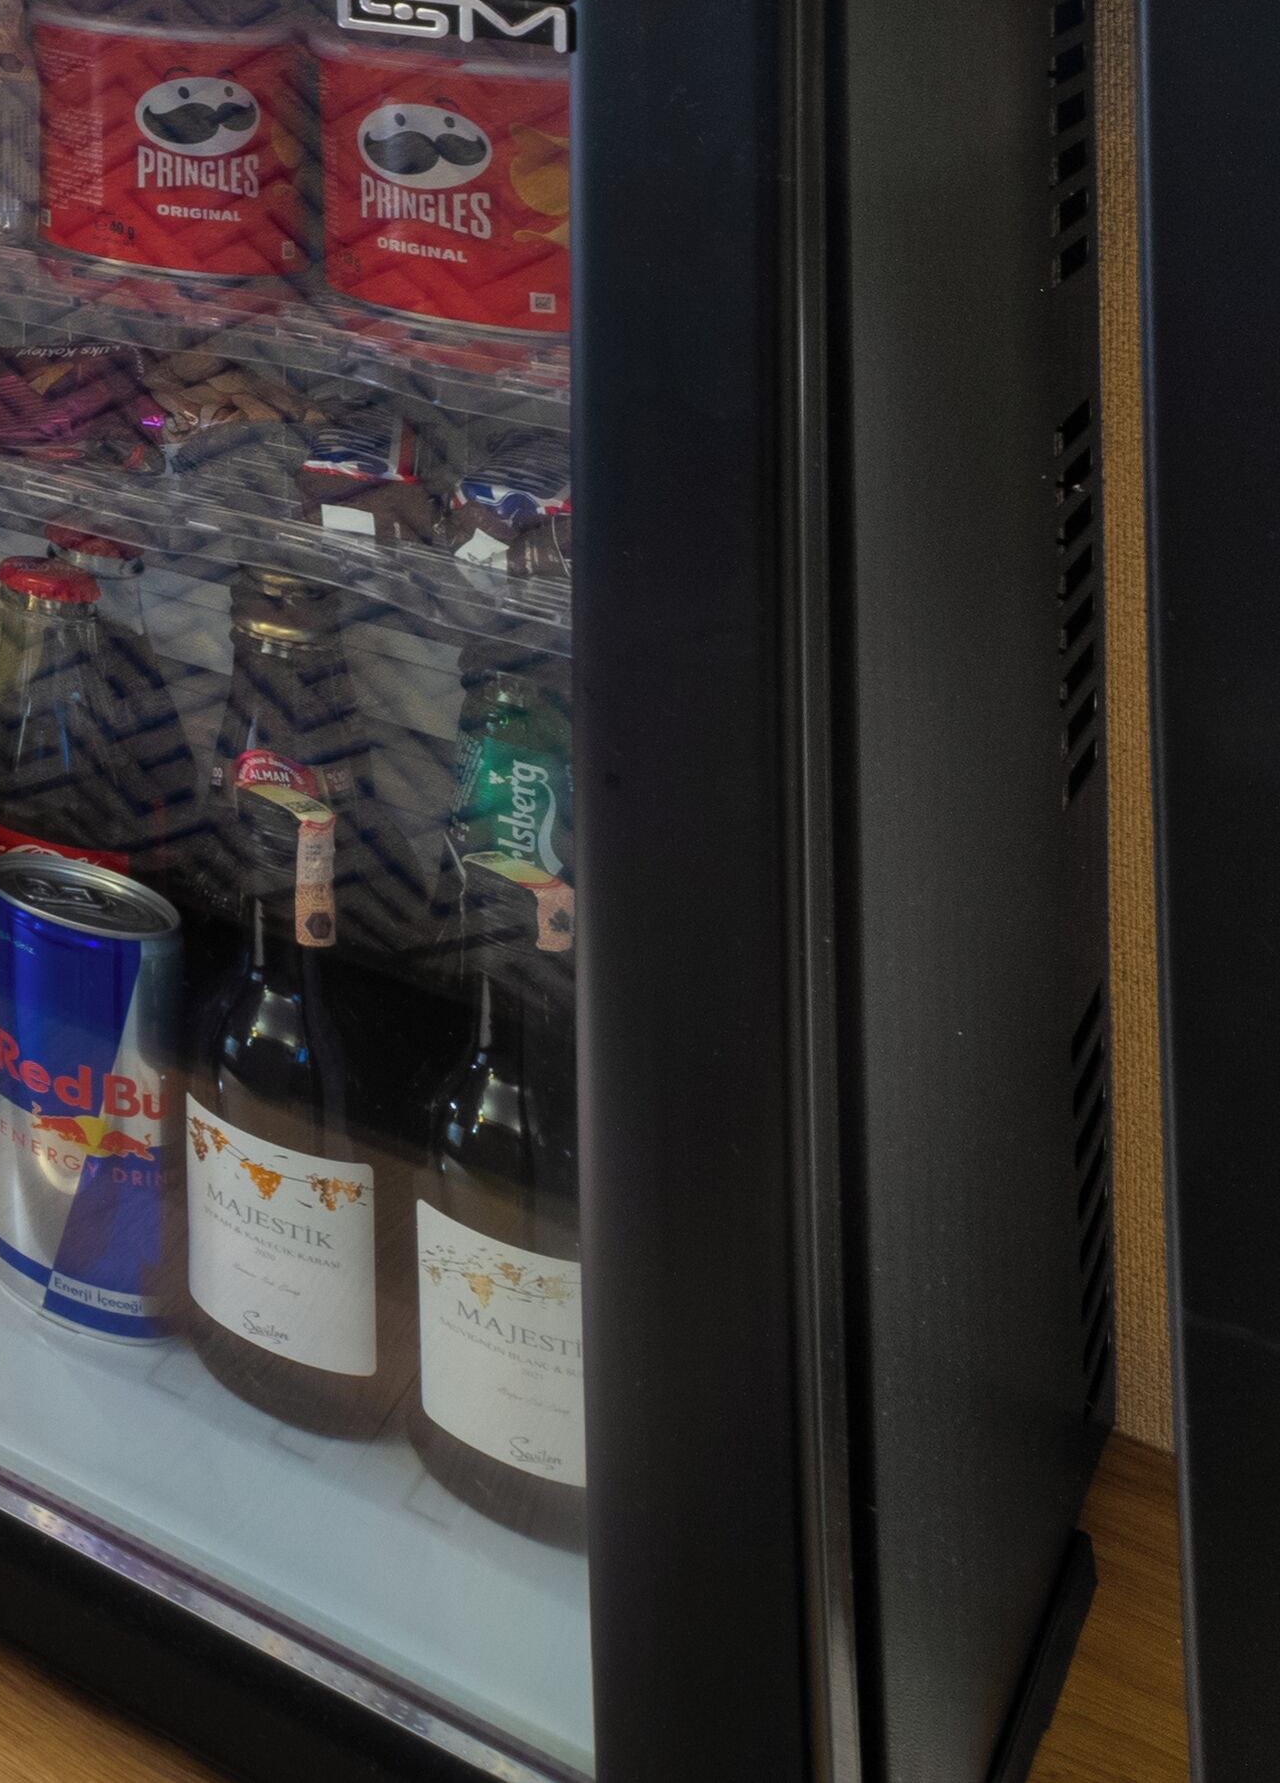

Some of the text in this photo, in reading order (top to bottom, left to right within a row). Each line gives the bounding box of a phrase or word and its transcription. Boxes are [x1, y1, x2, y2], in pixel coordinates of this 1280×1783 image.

[137, 144, 259, 199] PRINGLES
[156, 203, 243, 222] ORIGINAL
[360, 172, 491, 241] PRINGLES
[376, 236, 469, 264] ORIGINAL
[249, 768, 290, 784] ALMAN
[102, 1072, 167, 1121] Bu
[0, 1118, 100, 1179] ENERGY
[206, 1182, 336, 1251] MAJESTİK
[54, 1277, 93, 1302] Enerji
